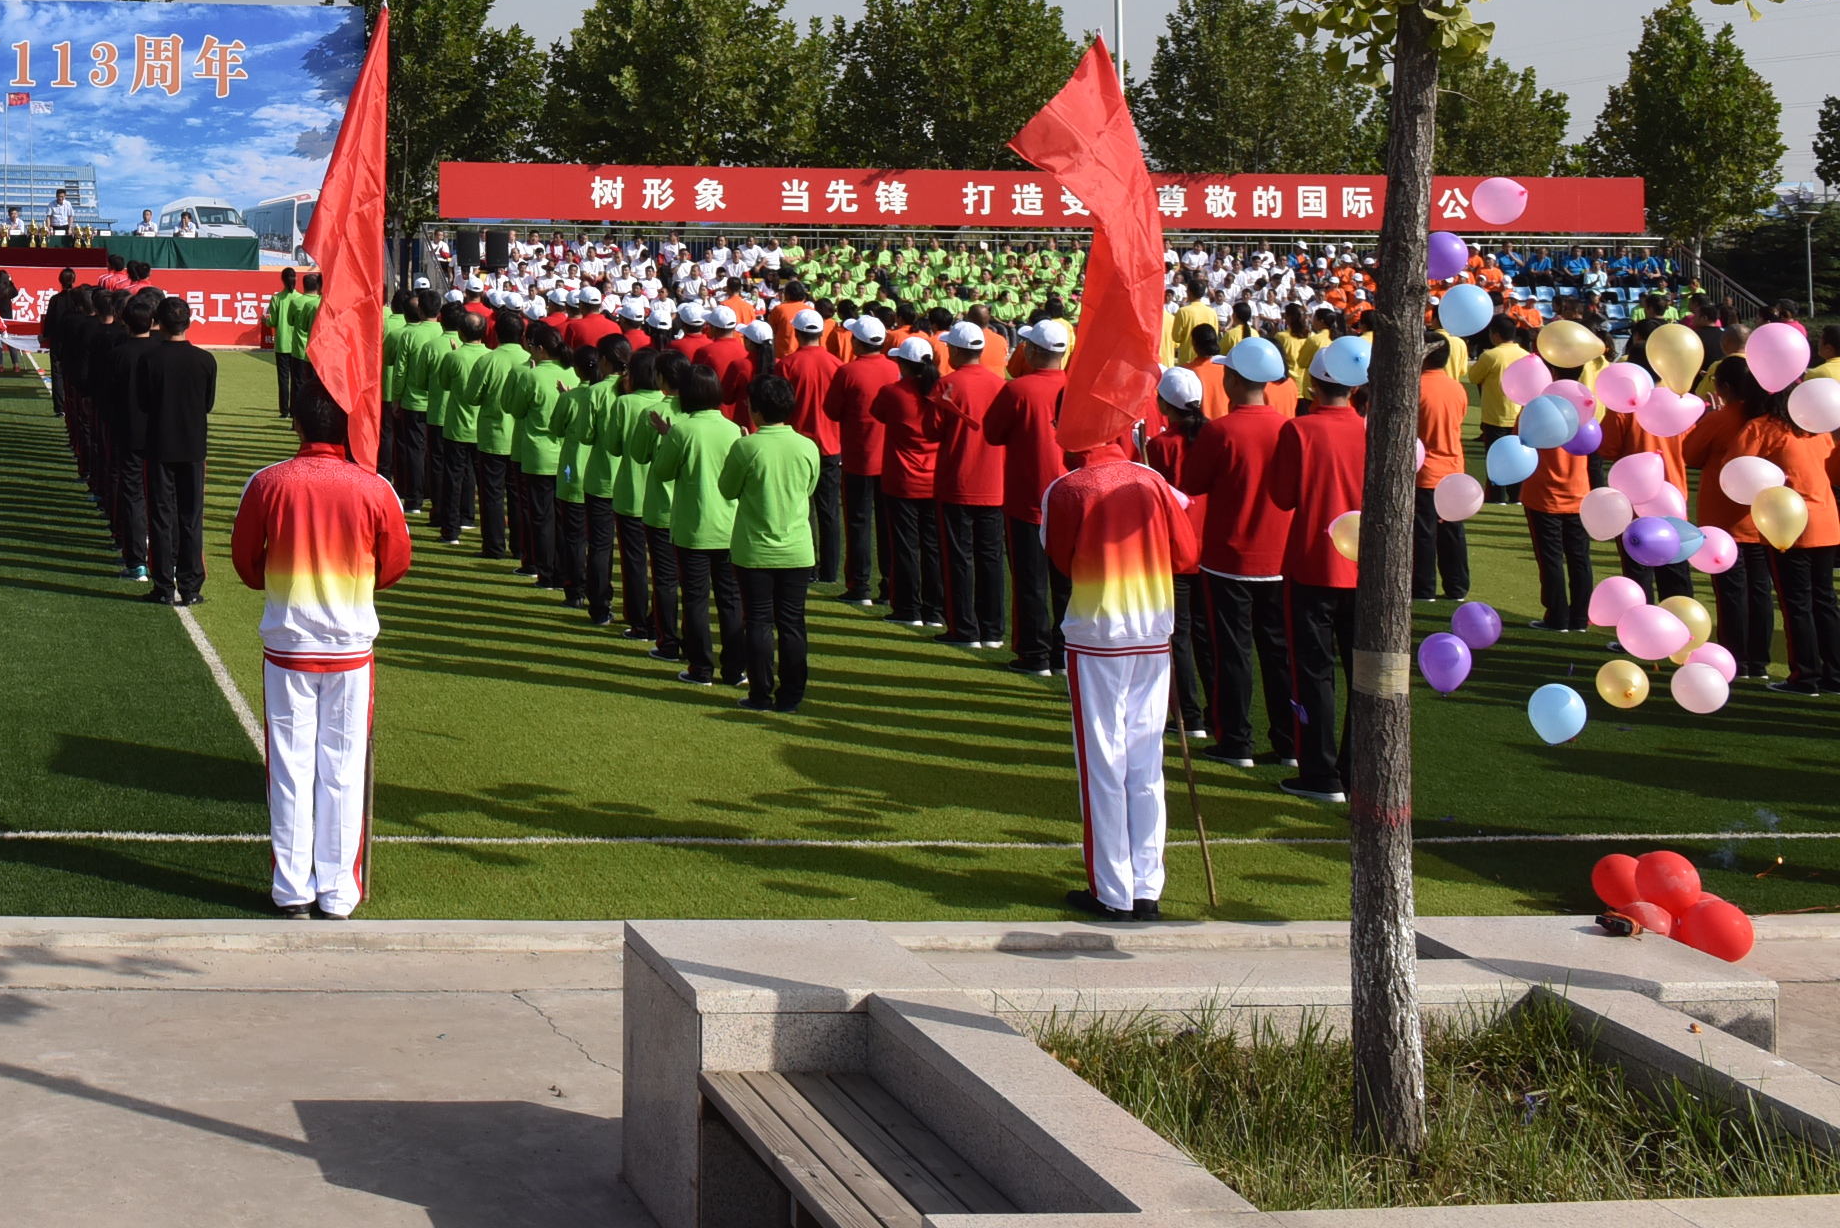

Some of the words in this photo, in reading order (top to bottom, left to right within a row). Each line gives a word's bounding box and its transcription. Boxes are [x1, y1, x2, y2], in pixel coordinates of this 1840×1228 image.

[590, 175, 727, 211] 树形象
[780, 179, 909, 215] 当先锋
